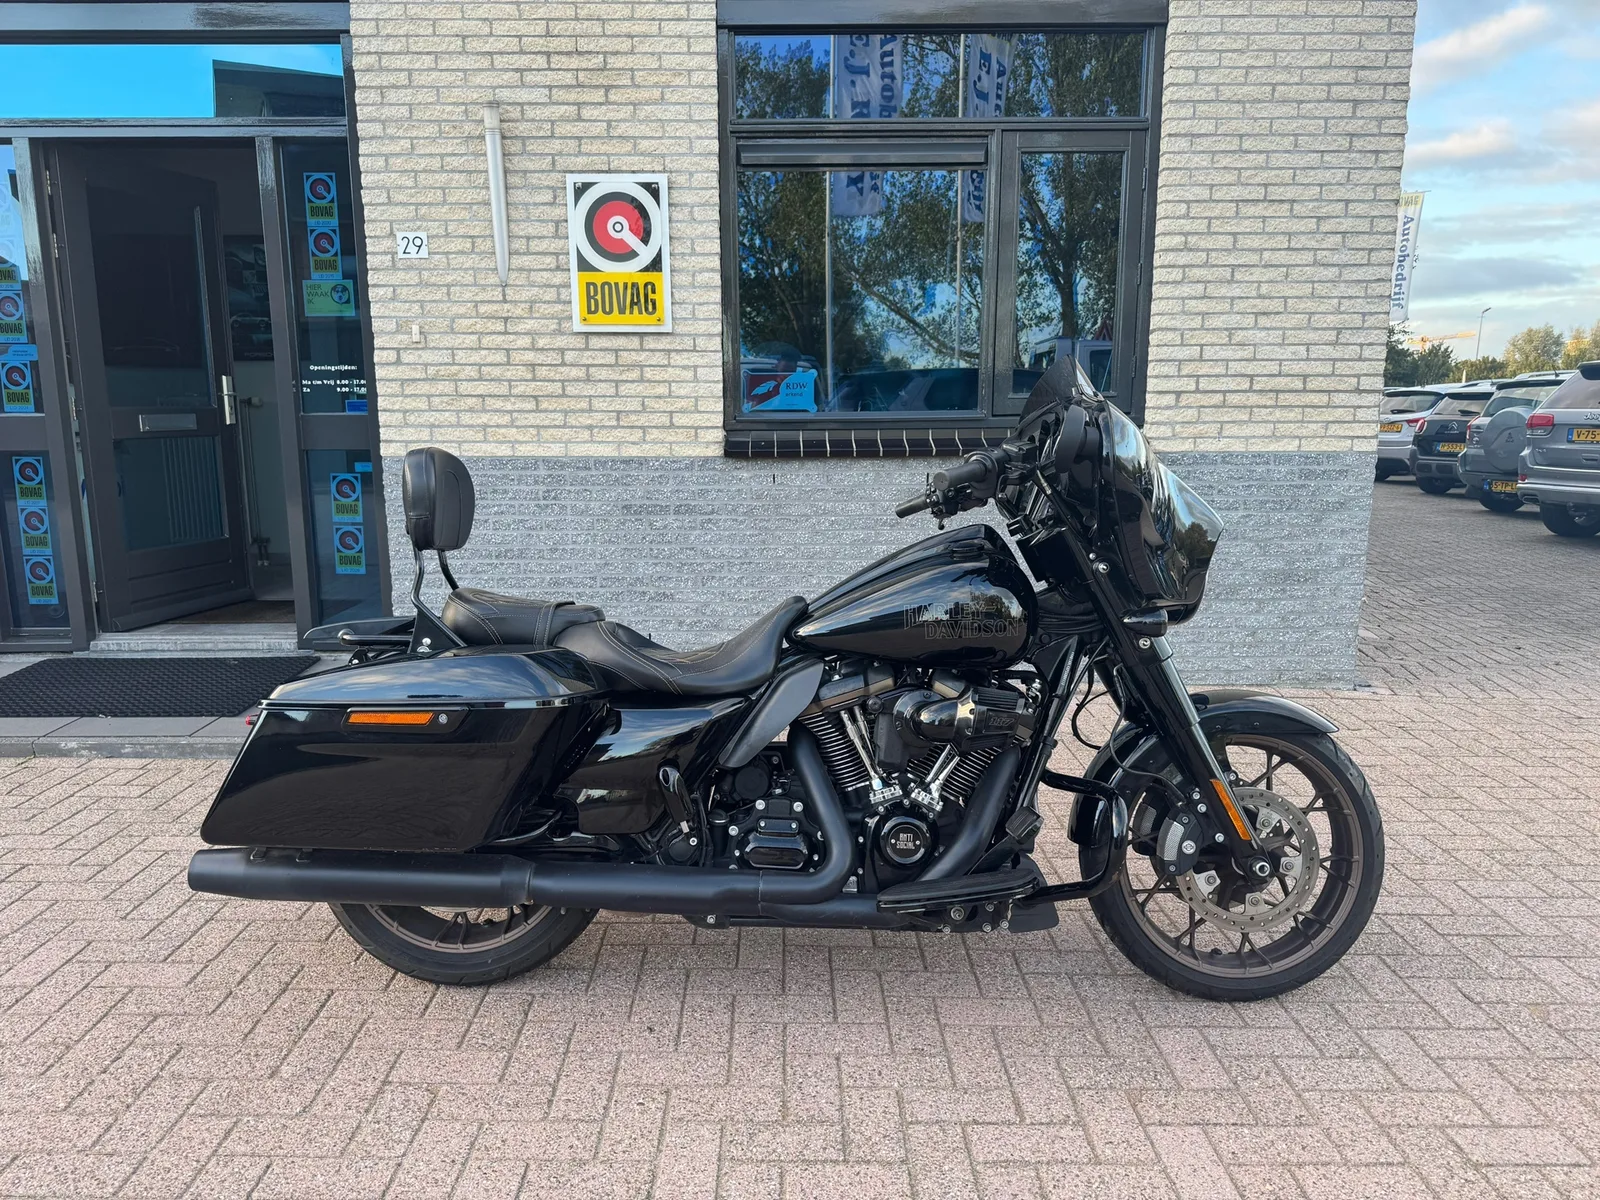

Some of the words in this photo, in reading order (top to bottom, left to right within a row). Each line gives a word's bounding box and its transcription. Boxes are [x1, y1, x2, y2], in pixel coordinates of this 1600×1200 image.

[309, 205, 334, 218] BOVAG
[401, 236, 424, 255] 29
[314, 259, 338, 271] BOVAG
[1391, 214, 1415, 310] Autobedrijf
[305, 283, 323, 291] HIER
[306, 290, 330, 298] WAAK
[585, 281, 658, 316] BOVAG
[0, 322, 23, 334] BOVAG
[309, 364, 358, 372] Openingstijden:
[785, 382, 808, 390] RDW
[7, 391, 30, 403] BOVAG
[20, 486, 43, 498] BOVAG
[335, 503, 359, 515] BOVAG
[25, 536, 48, 547] BOVAG
[339, 555, 362, 566] BOVAG
[31, 585, 54, 596] BOVAG
[924, 618, 1019, 639] DAVIDSON
[896, 841, 915, 849] SOCIAL
